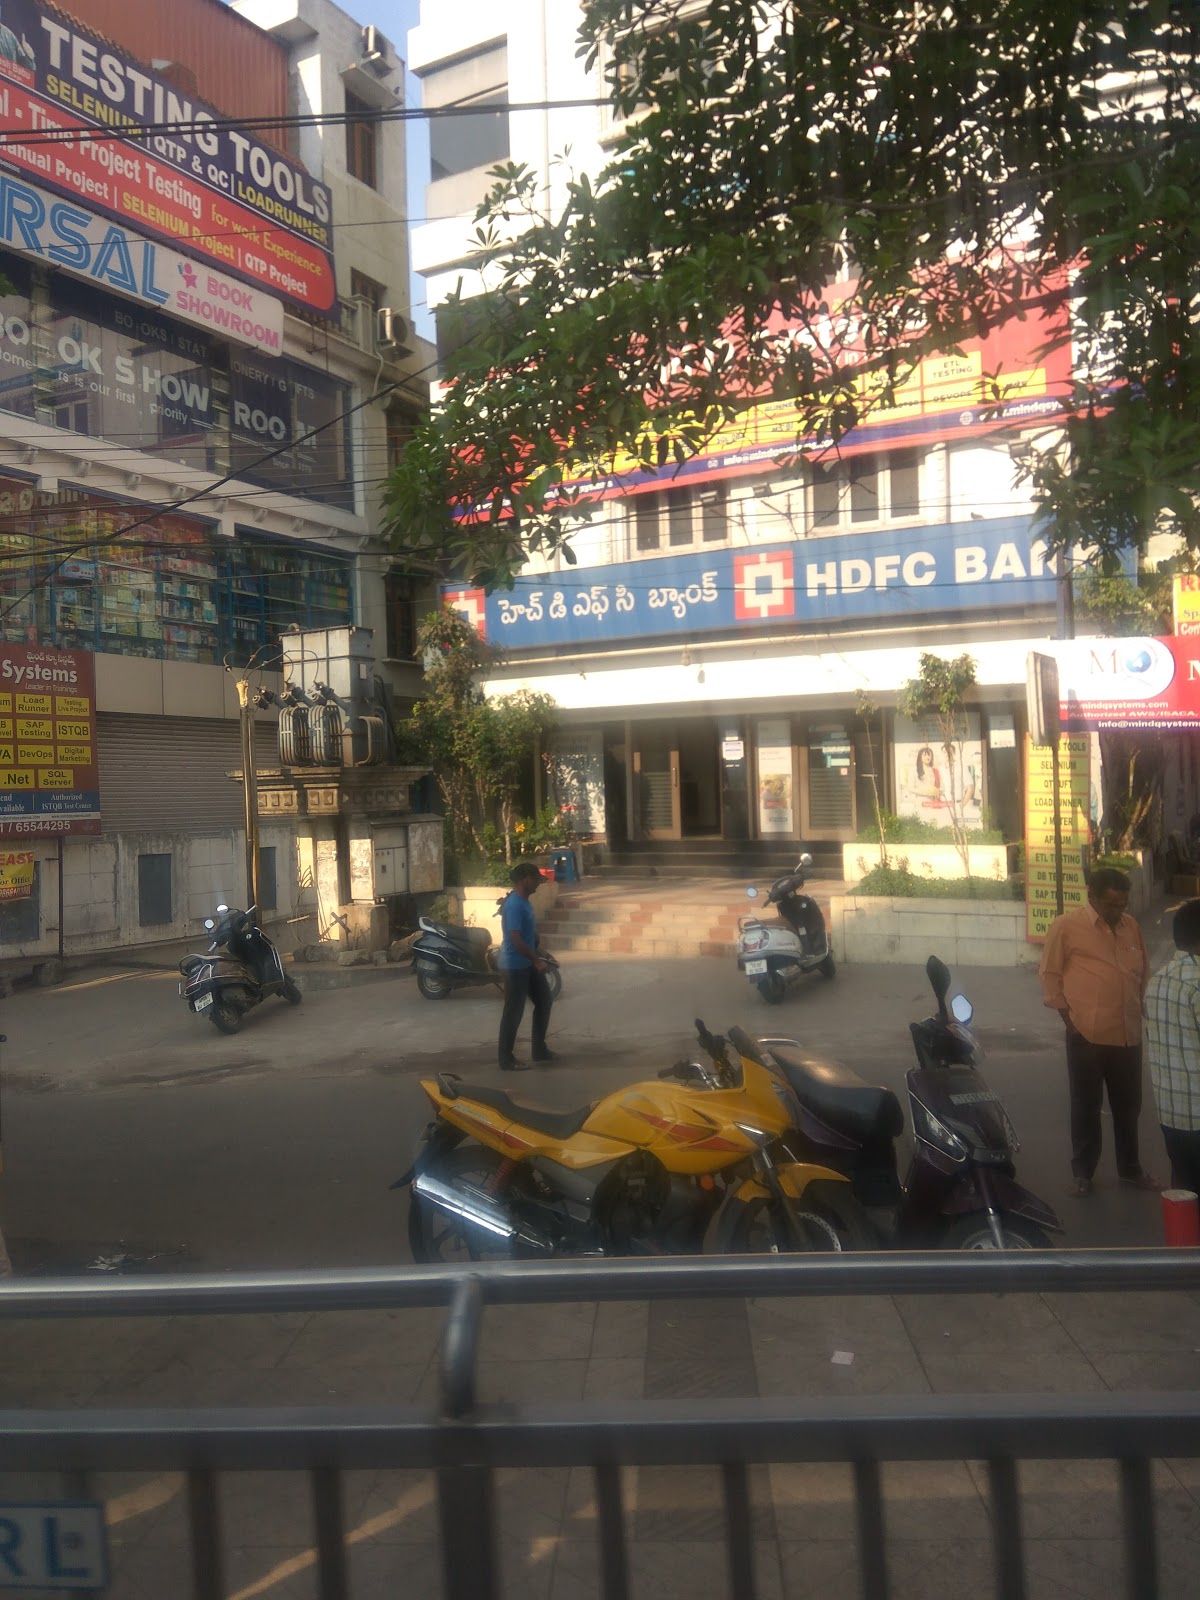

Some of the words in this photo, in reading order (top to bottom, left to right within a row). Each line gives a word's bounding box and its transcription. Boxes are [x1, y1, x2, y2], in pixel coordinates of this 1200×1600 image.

[41, 16, 219, 156] TESTING
[229, 131, 329, 224] TOOLS
[155, 136, 187, 167] QTP
[192, 154, 204, 175] &
[207, 163, 229, 189] QC
[238, 181, 328, 246] LOADRUNNER
[80, 131, 141, 184] Project
[145, 162, 202, 219] Testing
[211, 203, 229, 227] for
[231, 221, 260, 245] work
[263, 231, 323, 277] Experience
[55, 159, 109, 200] Project
[123, 191, 189, 237] SELENIUM
[192, 227, 235, 259] Project
[244, 252, 268, 275] QTP
[269, 266, 308, 297] Project
[207, 275, 253, 313] BOOK
[176, 289, 280, 350] SHOWROOM
[943, 359, 960, 369] ETL
[932, 366, 974, 380] TESTING
[115, 355, 210, 412] SHOW
[90, 382, 110, 397] our
[115, 387, 136, 405] first
[150, 402, 189, 425] priority
[806, 551, 938, 598] HDFC
[497, 591, 544, 625] హెచ్
[548, 590, 568, 620] డి
[615, 584, 636, 613] సి
[647, 571, 719, 620] బ్యాంక్
[2, 659, 78, 683] Systems
[25, 682, 45, 691] Leader
[53, 684, 78, 695] Trainings
[63, 698, 82, 707] Testing
[18, 704, 50, 713] Runner
[1069, 710, 1126, 718] Authorized
[19, 728, 51, 738] Testing
[58, 725, 89, 736] ISTQB
[64, 747, 85, 756] Digital
[1063, 742, 1087, 752] TOOLS
[20, 749, 53, 759] DevOps
[59, 755, 91, 764] Marketing
[1040, 760, 1078, 770] SELNIUM
[3, 773, 30, 785] .Net
[47, 770, 67, 778] SQL
[43, 778, 71, 786] Server
[51, 793, 83, 801] Authorized
[42, 802, 63, 811] ISTQB
[1034, 797, 1082, 808] LOADUNNER
[15, 820, 71, 833] 65544295
[1049, 817, 1073, 826] MTER
[1035, 853, 1048, 863] ETL
[1037, 871, 1047, 881] DB
[1035, 889, 1049, 899] SAP
[1032, 908, 1049, 918] LIVE
[1035, 923, 1047, 932] ON
